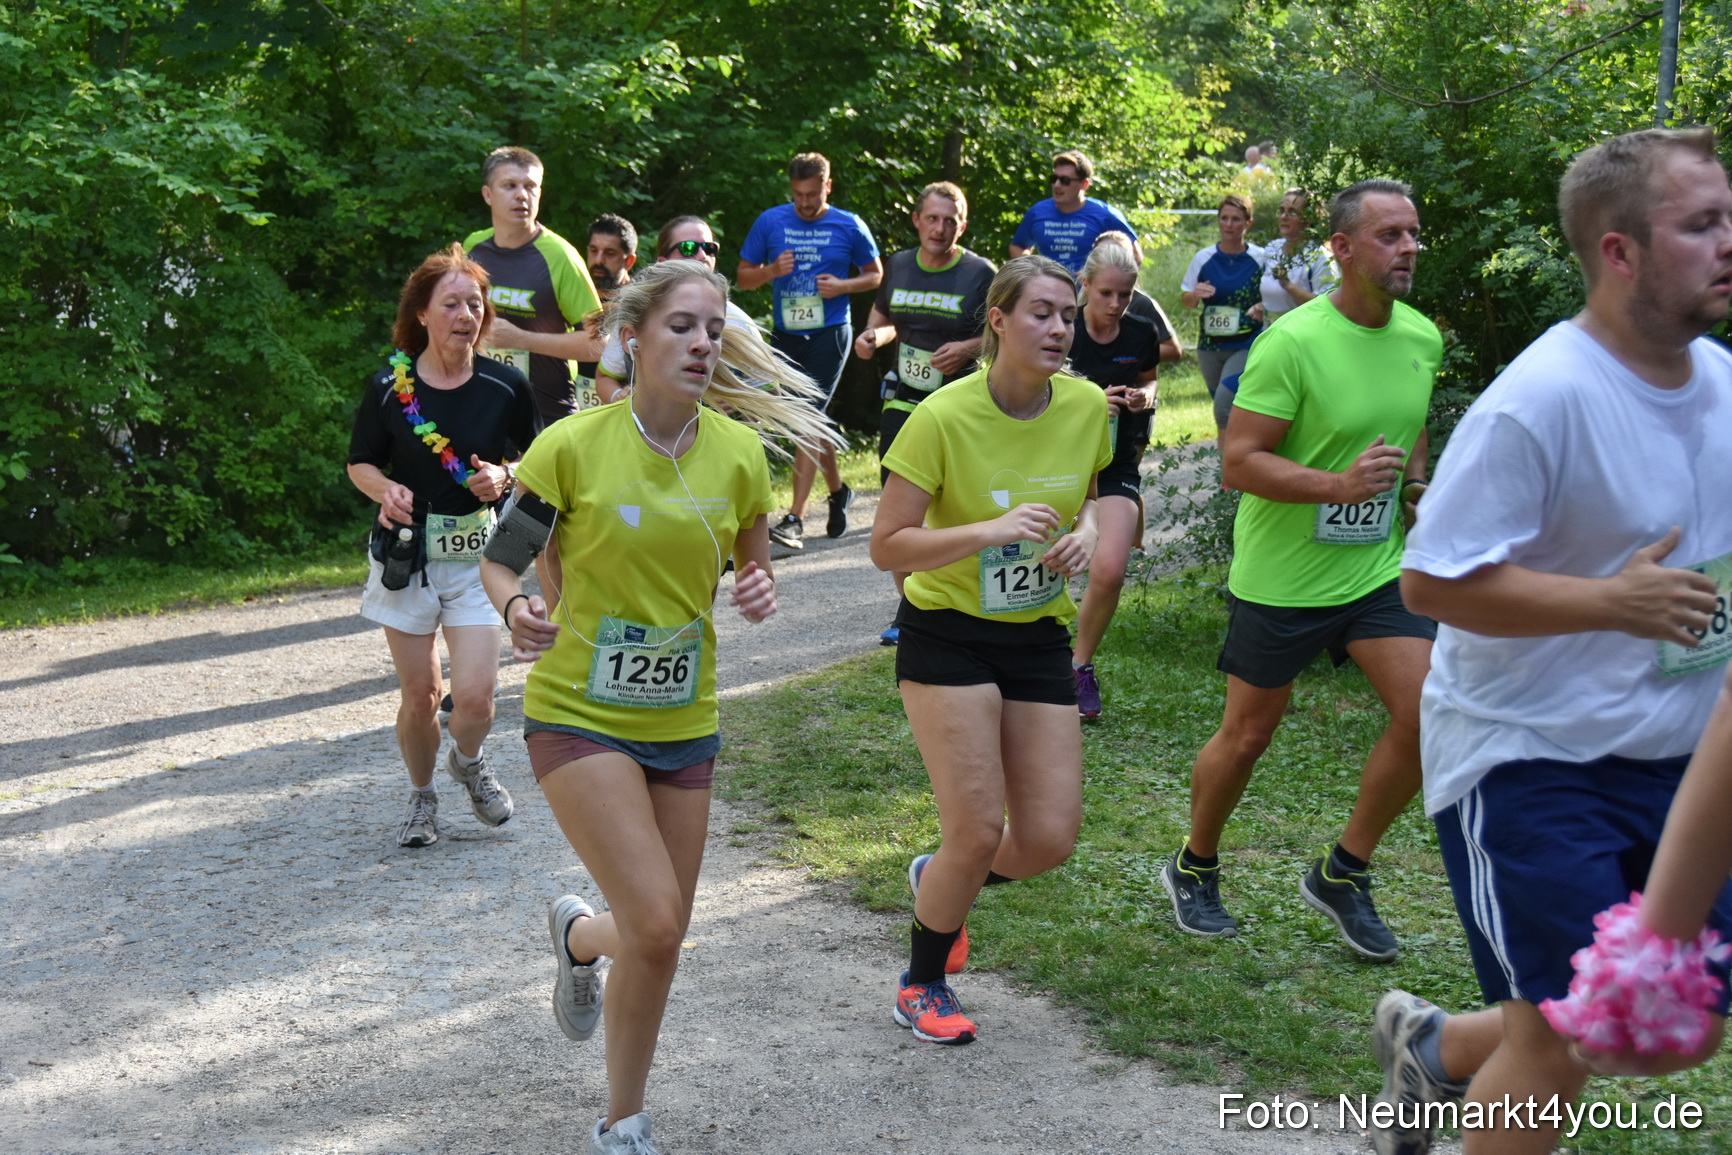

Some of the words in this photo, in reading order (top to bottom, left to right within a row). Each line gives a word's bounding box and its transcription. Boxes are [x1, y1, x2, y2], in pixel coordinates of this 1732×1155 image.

[784, 228, 804, 237] Wenn
[814, 229, 832, 237] beim
[794, 254, 821, 262] AUFEN
[487, 287, 533, 309] CK
[890, 289, 963, 312] BOCK
[790, 308, 815, 320] 724
[1209, 316, 1230, 328] 266
[905, 360, 931, 380] 336
[582, 391, 605, 407] 95
[1325, 501, 1388, 526] 2027
[1030, 586, 1052, 597] Renate
[608, 651, 690, 685] 1256
[605, 681, 637, 693] Lehner
[639, 685, 685, 694] Anna-Maria
